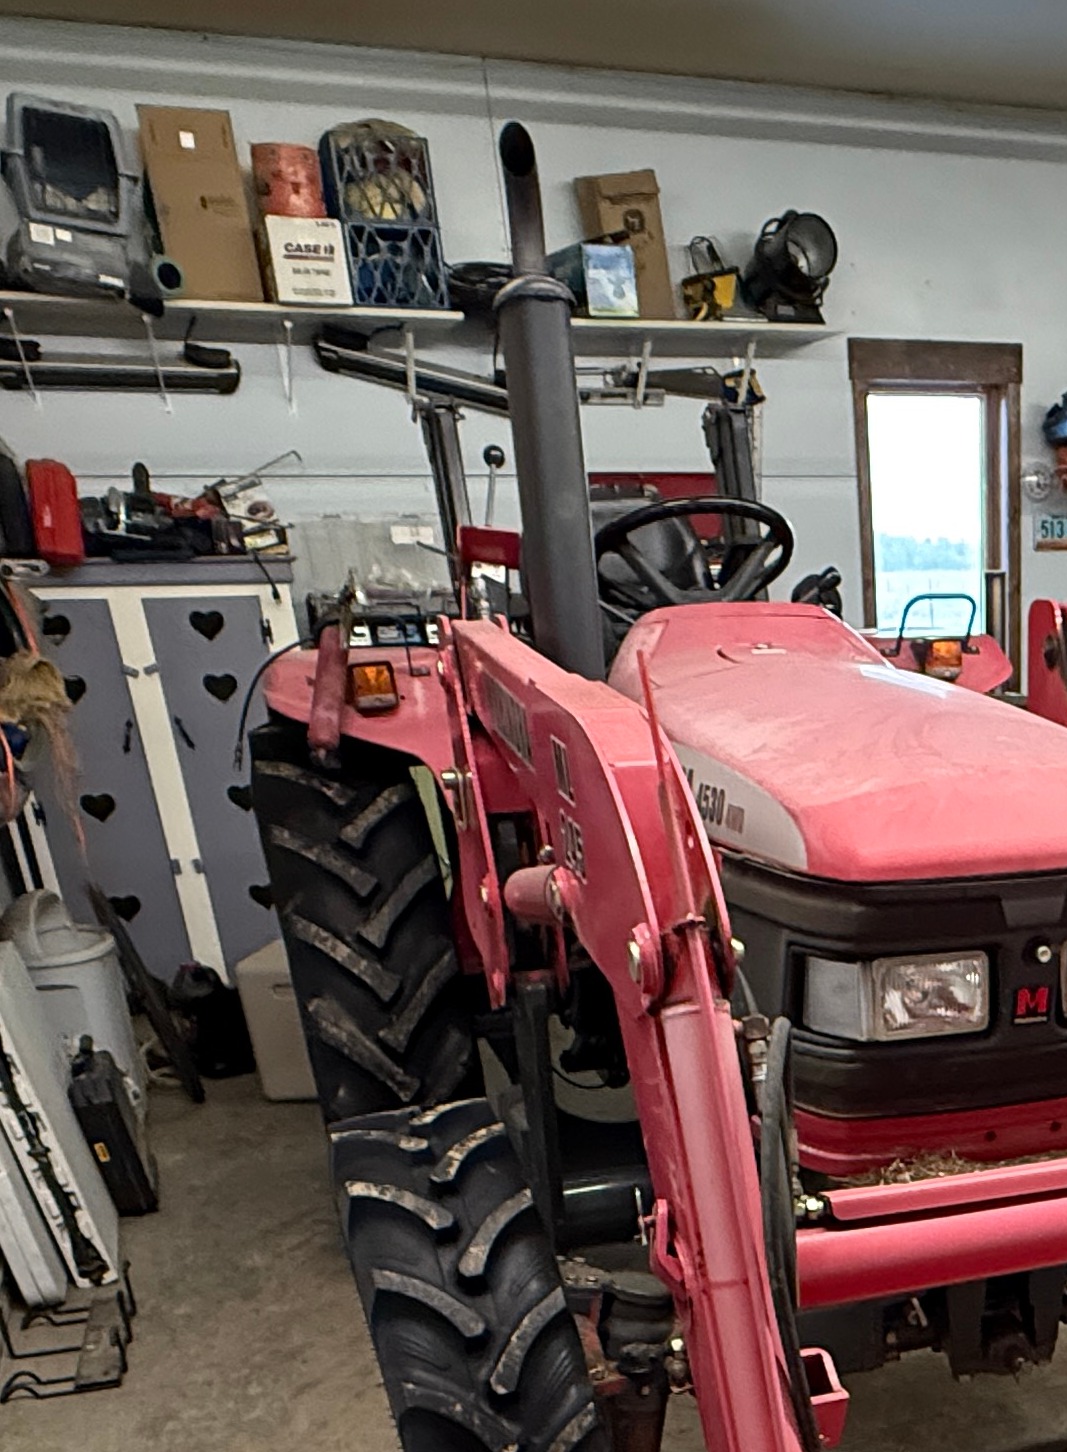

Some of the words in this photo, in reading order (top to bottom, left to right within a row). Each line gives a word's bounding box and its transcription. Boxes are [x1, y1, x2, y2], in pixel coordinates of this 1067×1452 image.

[283, 242, 321, 255] CASE
[1041, 520, 1064, 539] 513
[1015, 986, 1049, 1016] M
